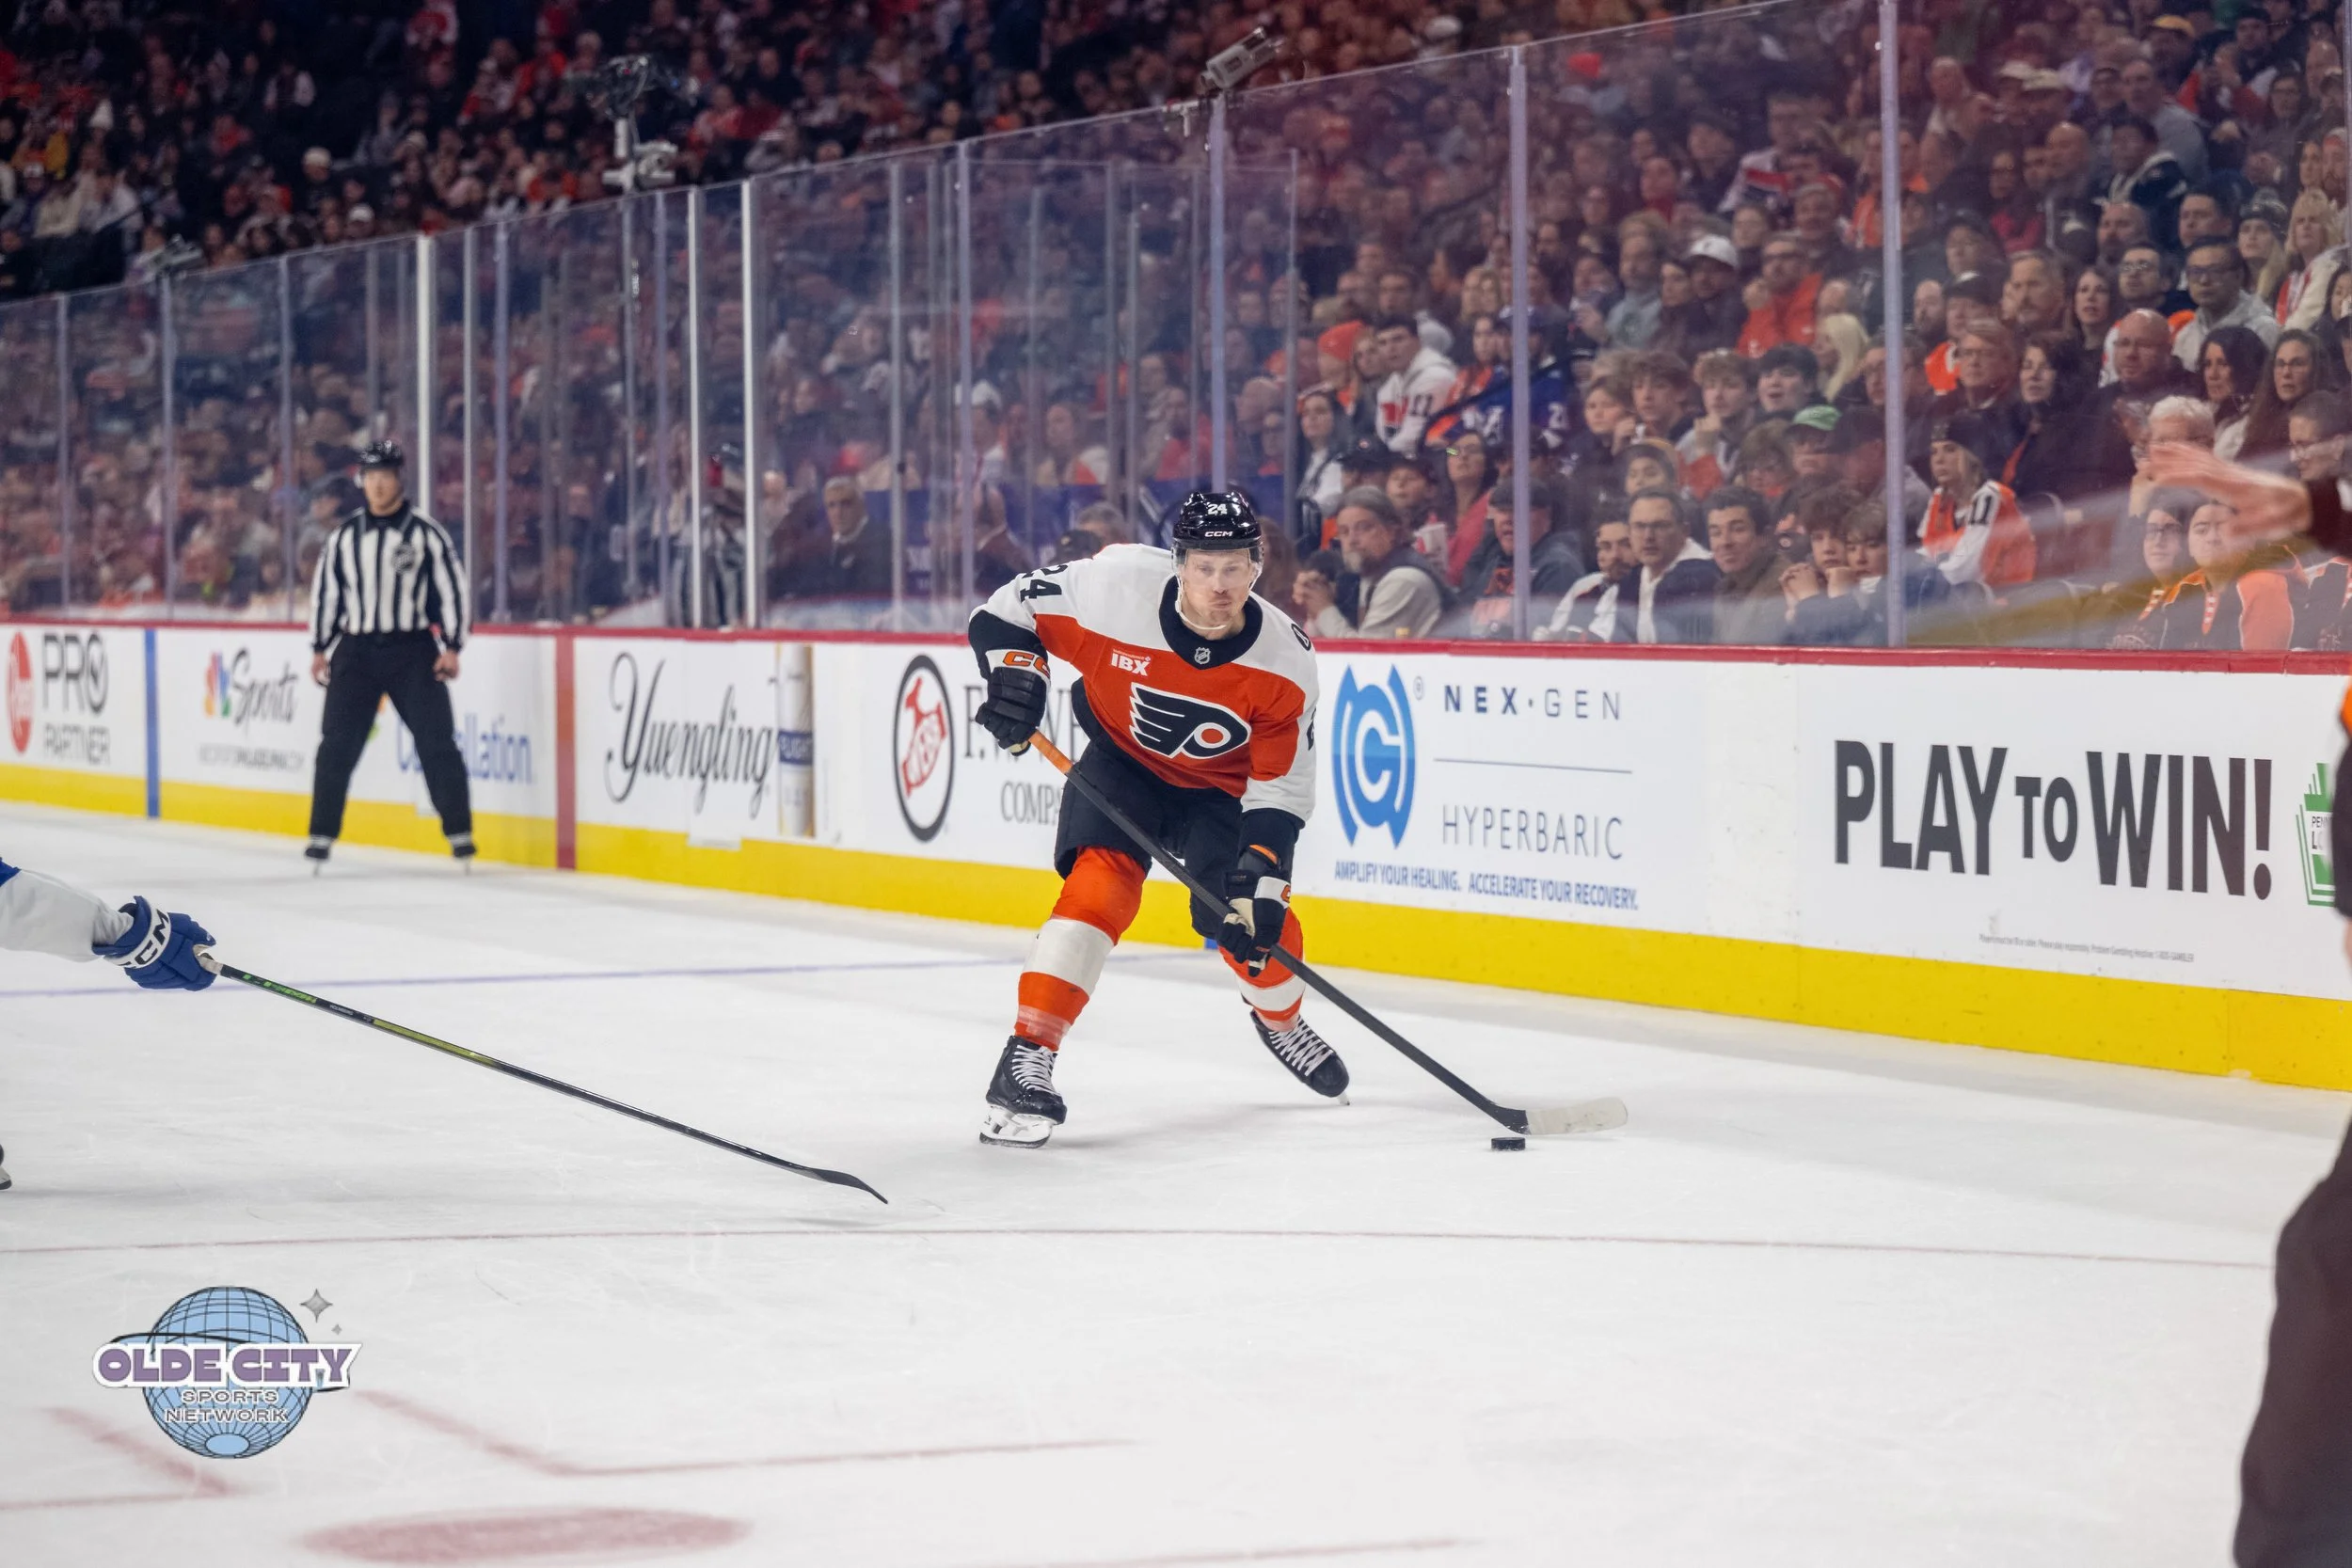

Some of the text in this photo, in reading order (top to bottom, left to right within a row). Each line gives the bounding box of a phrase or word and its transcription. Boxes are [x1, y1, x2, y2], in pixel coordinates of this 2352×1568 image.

[1208, 503, 1228, 515] 24
[42, 633, 109, 715] PRO
[231, 648, 298, 732] Sports
[1003, 651, 1051, 679] CC
[1111, 653, 1151, 677] IBX
[604, 652, 773, 820] Yuengling
[1442, 805, 1624, 860] HYPERBARIC
[1835, 739, 2272, 900] PLAY TO WIN!
[1335, 861, 1639, 910] AMPLIFY YOUR HEALING. ACCELERATE YOUR RECOVERY.
